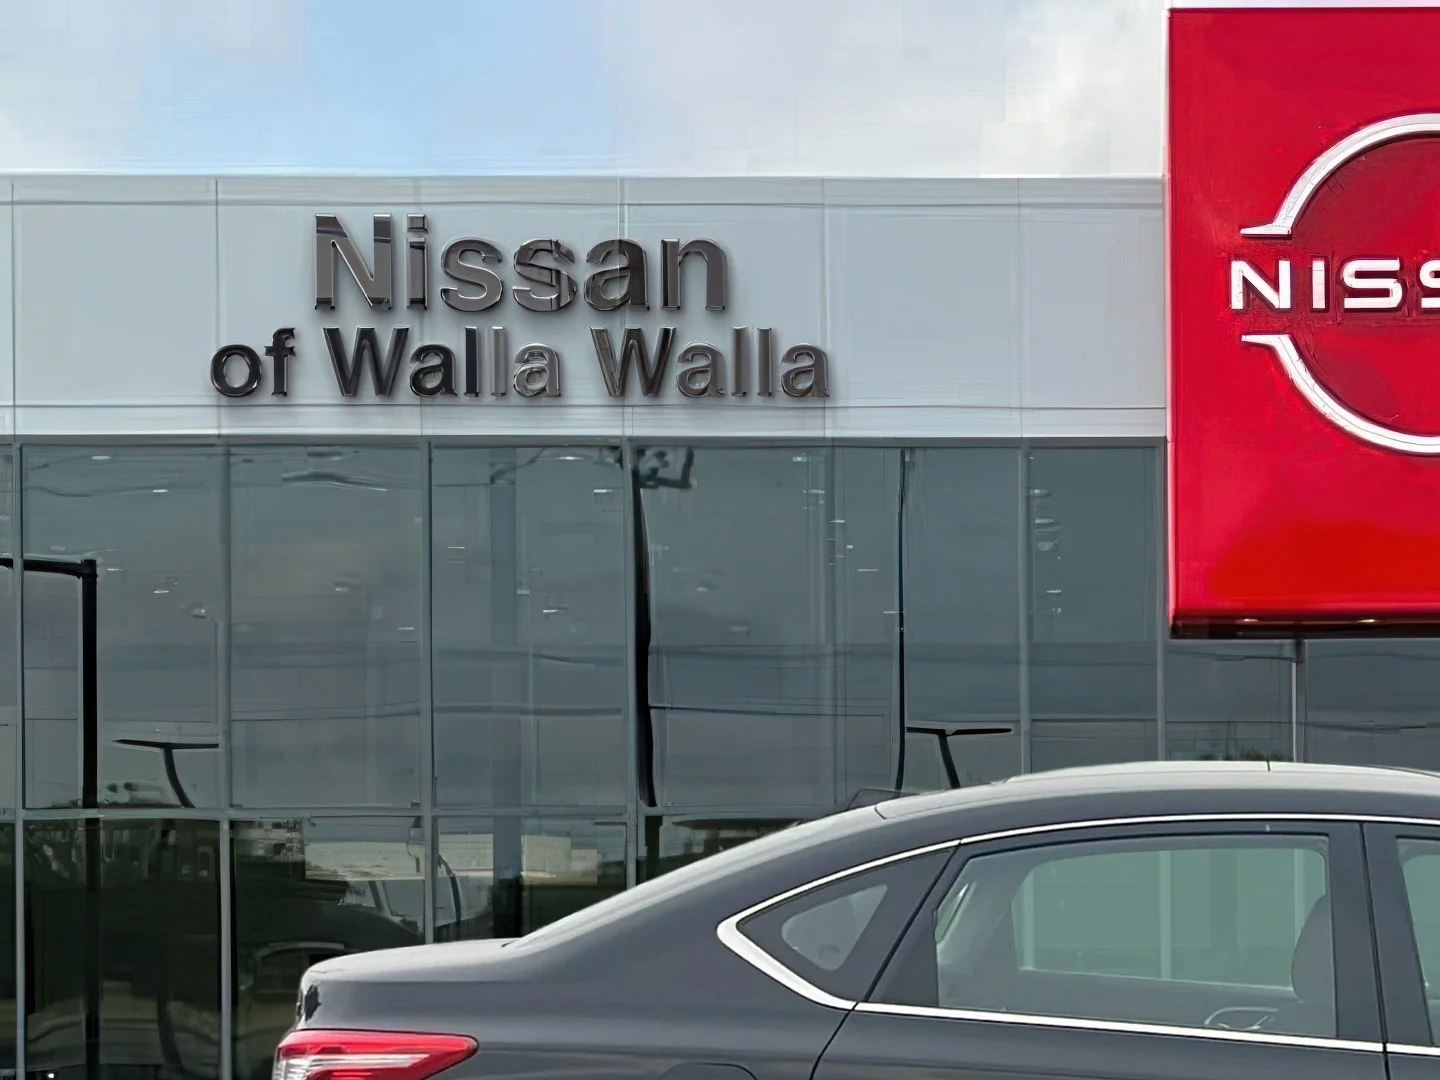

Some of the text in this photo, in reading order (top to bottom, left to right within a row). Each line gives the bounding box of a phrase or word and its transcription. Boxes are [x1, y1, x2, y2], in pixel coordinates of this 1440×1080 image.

[314, 213, 727, 312] Nissan
[210, 326, 831, 397] of Walla Walla
